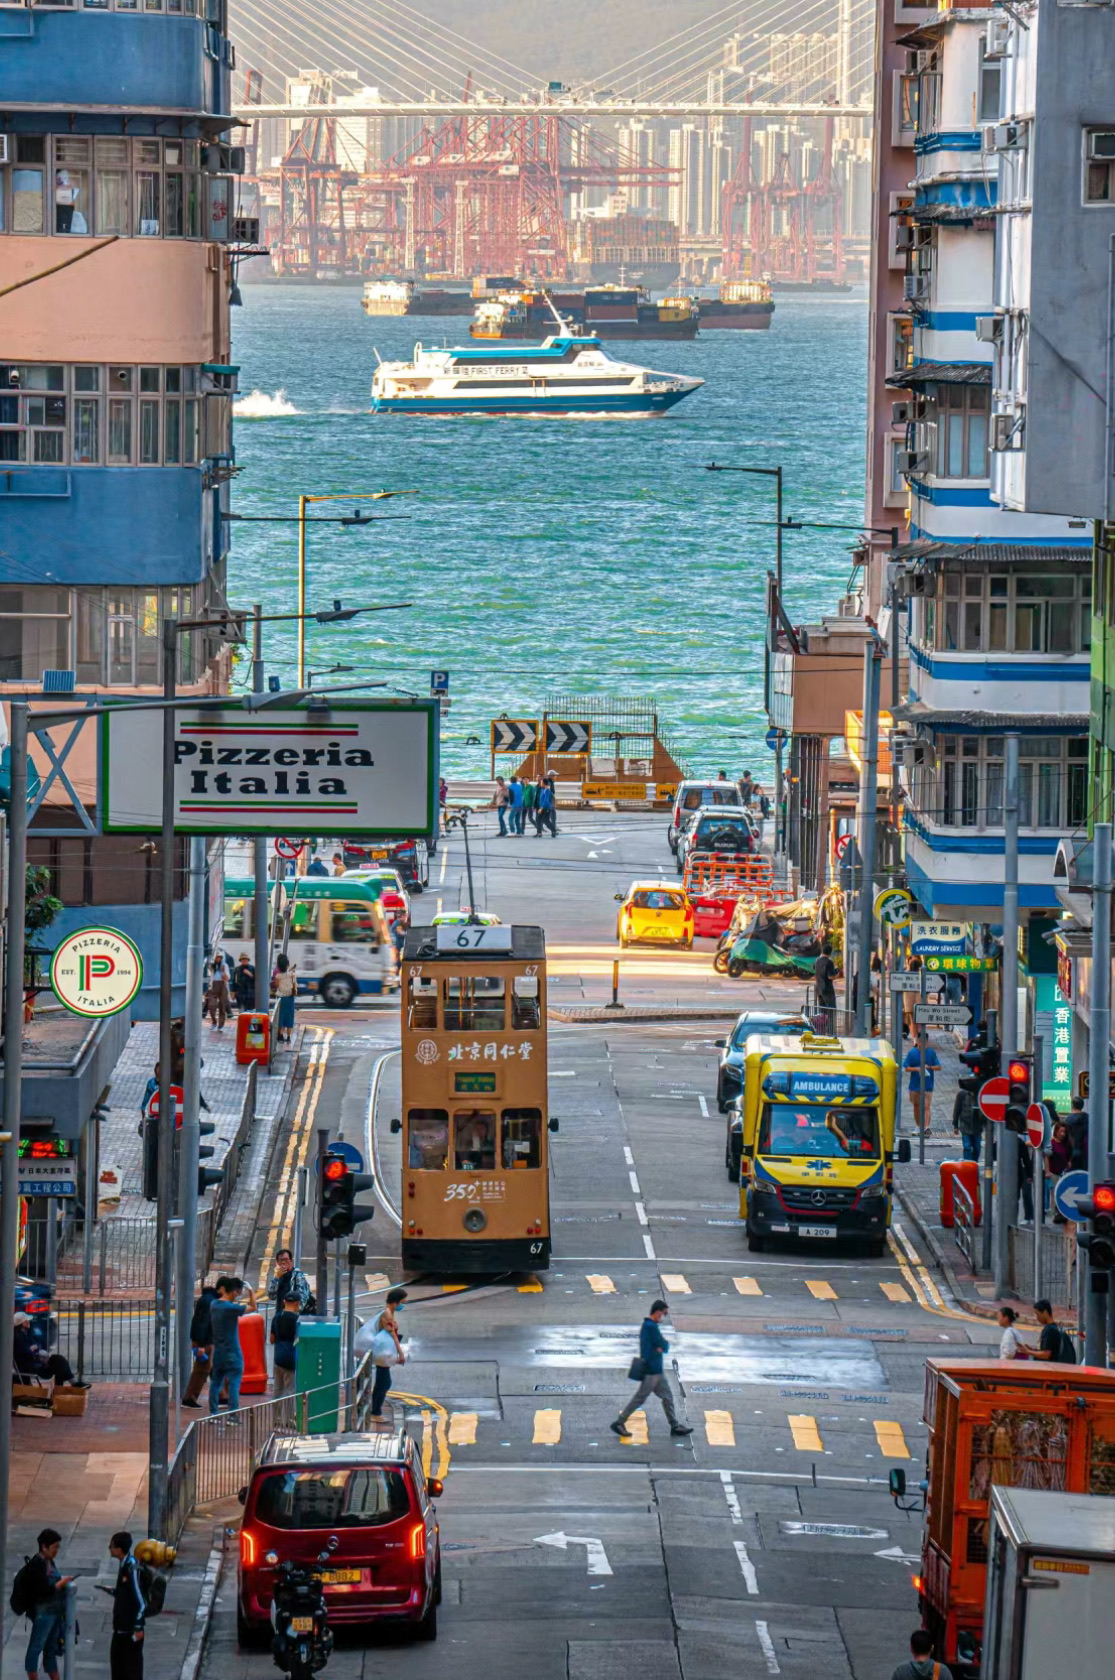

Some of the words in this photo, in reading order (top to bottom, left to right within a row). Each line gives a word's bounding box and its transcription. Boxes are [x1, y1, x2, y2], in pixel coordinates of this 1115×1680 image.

[434, 672, 446, 687] P
[174, 740, 375, 767] Pizzeria
[190, 770, 348, 795] Italia
[917, 926, 961, 935] 洗衣服務
[456, 929, 487, 948] 67
[72, 938, 121, 954] PIZZERIA
[916, 944, 940, 952] LAUNDRY
[941, 944, 962, 952] SERVICE
[409, 966, 423, 976] 67
[525, 965, 539, 976] 67
[77, 995, 115, 1007] ITALIA
[448, 1041, 533, 1061] 北京同仁堂
[1054, 1007, 1070, 1083] 香港置業
[794, 1081, 849, 1092] AMBULANCE
[530, 1243, 543, 1254] 67
